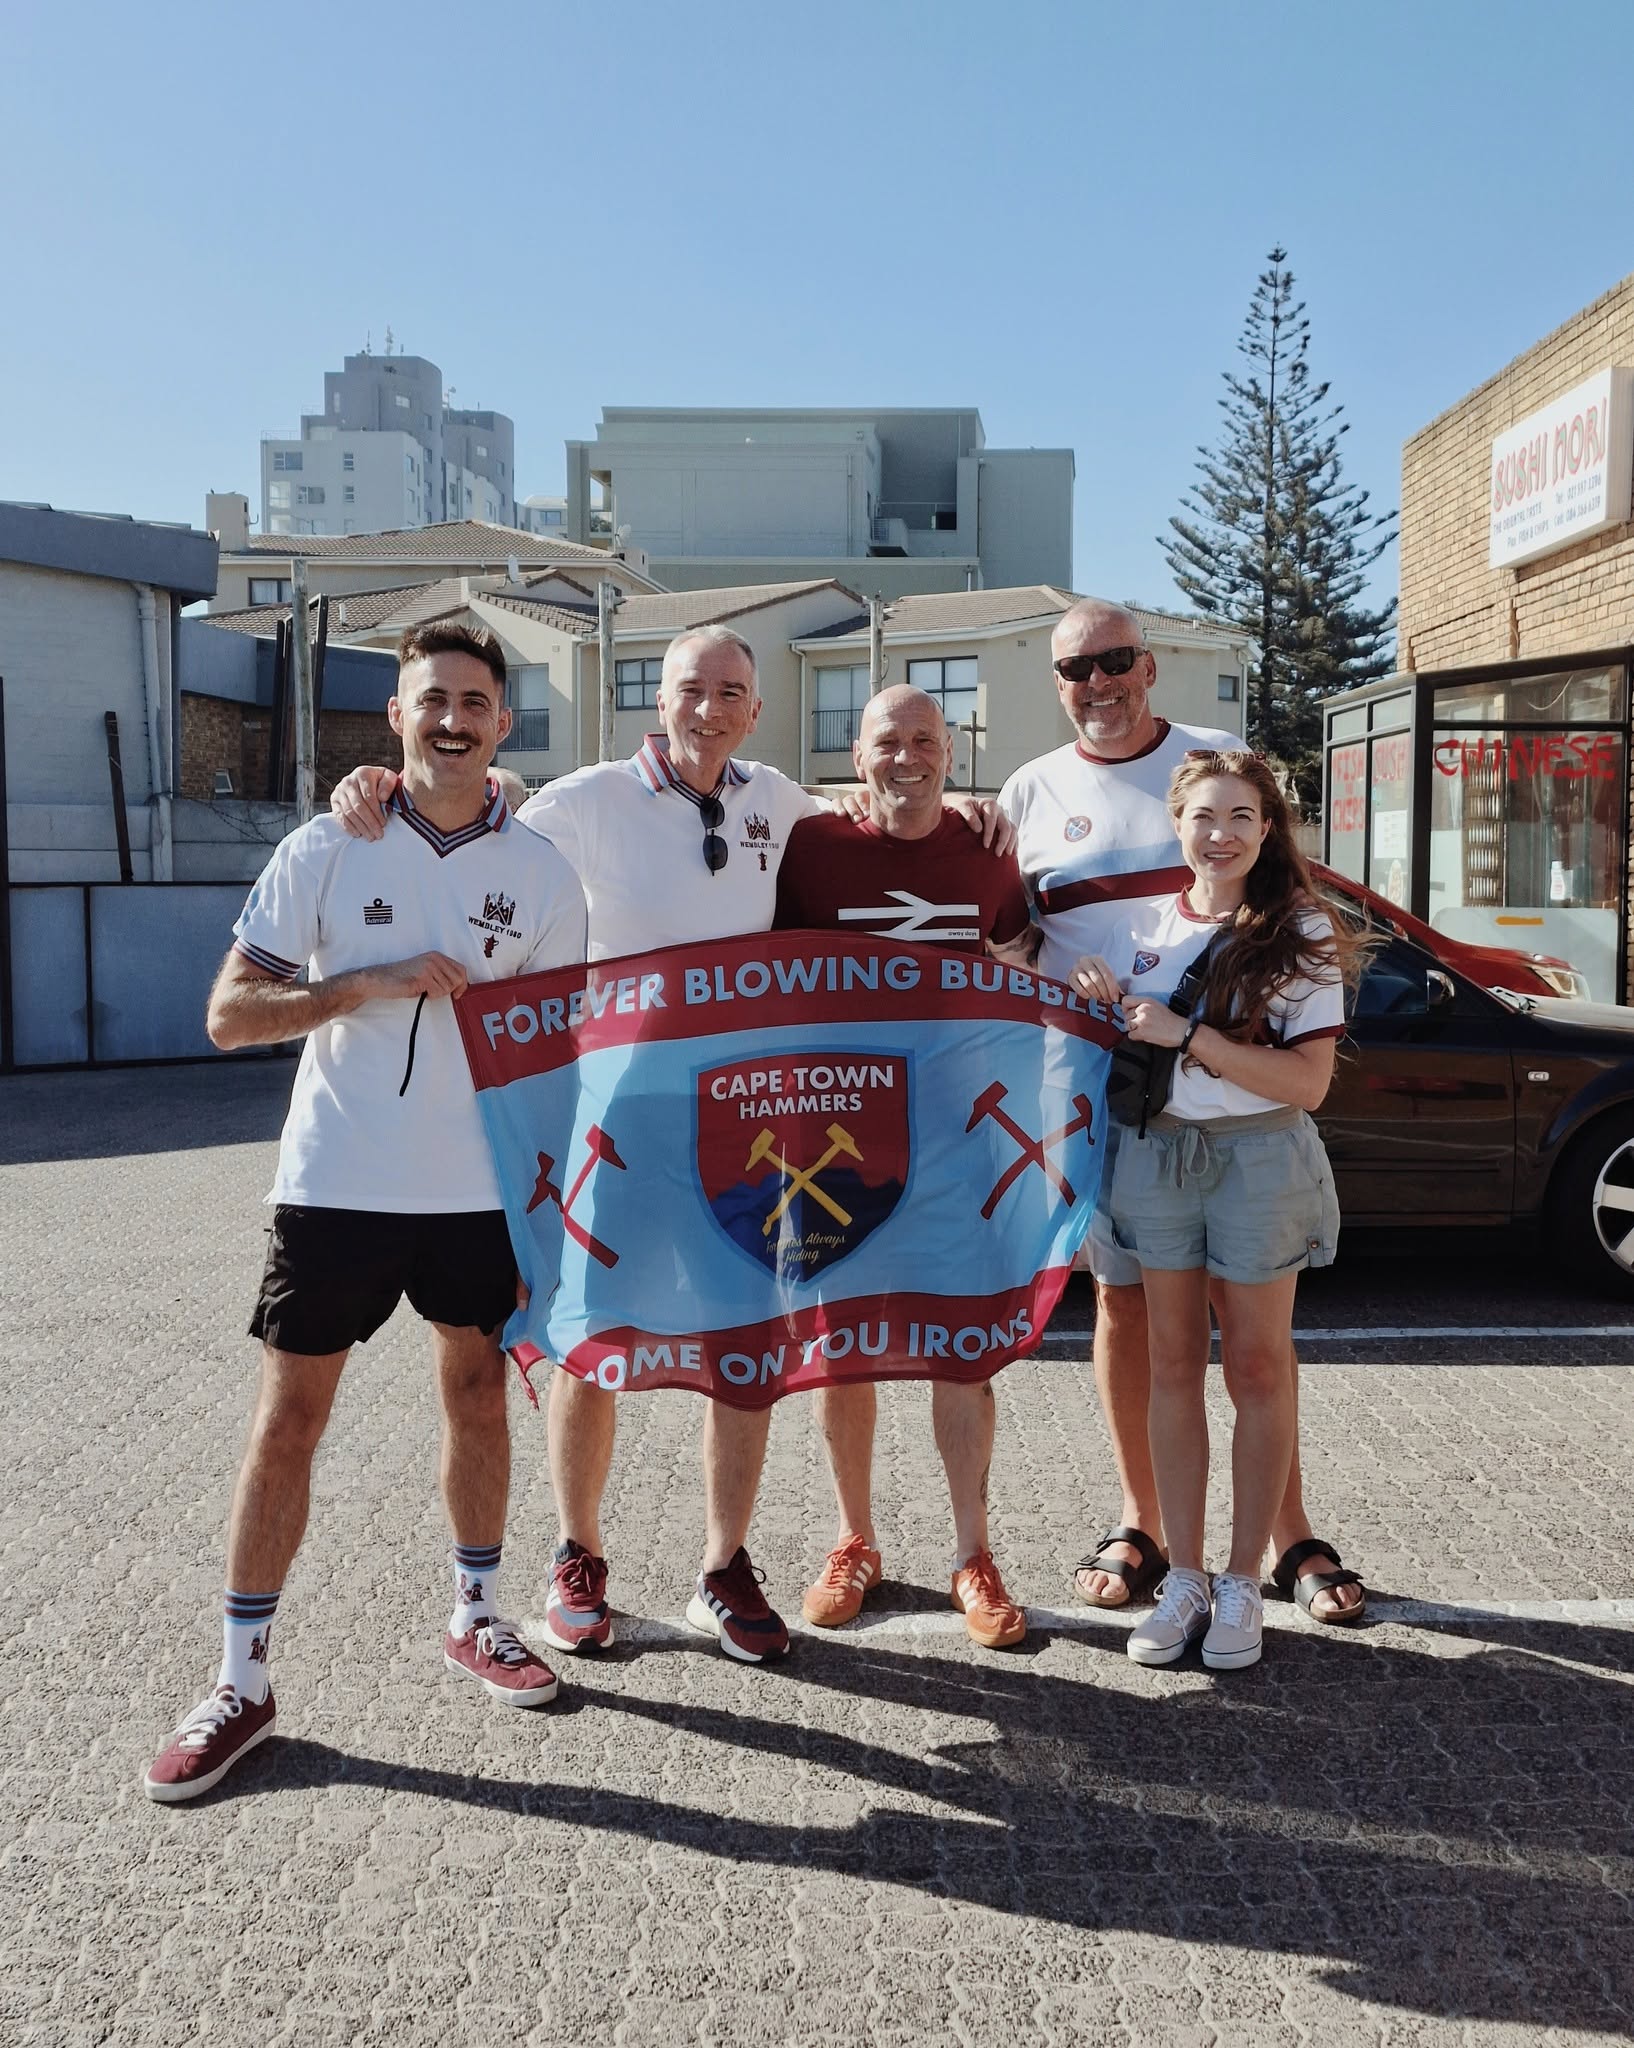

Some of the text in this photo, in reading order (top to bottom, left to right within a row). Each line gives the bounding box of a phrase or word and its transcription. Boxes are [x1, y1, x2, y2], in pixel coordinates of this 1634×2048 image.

[1493, 398, 1607, 513] SUSHI NORI
[1434, 735, 1615, 780] CHINESE
[366, 915, 392, 924] Admiral
[468, 915, 506, 934] WEMBLEY
[481, 955, 1131, 1051] FOREVER BLOWING BUBBLES
[710, 1065, 894, 1101] CAPE TOWN
[740, 1094, 862, 1119] HAMMERS
[804, 1232, 847, 1249] Always
[785, 1248, 820, 1265] Hiding
[583, 1308, 1034, 1391] OME ON YOU IRONS
